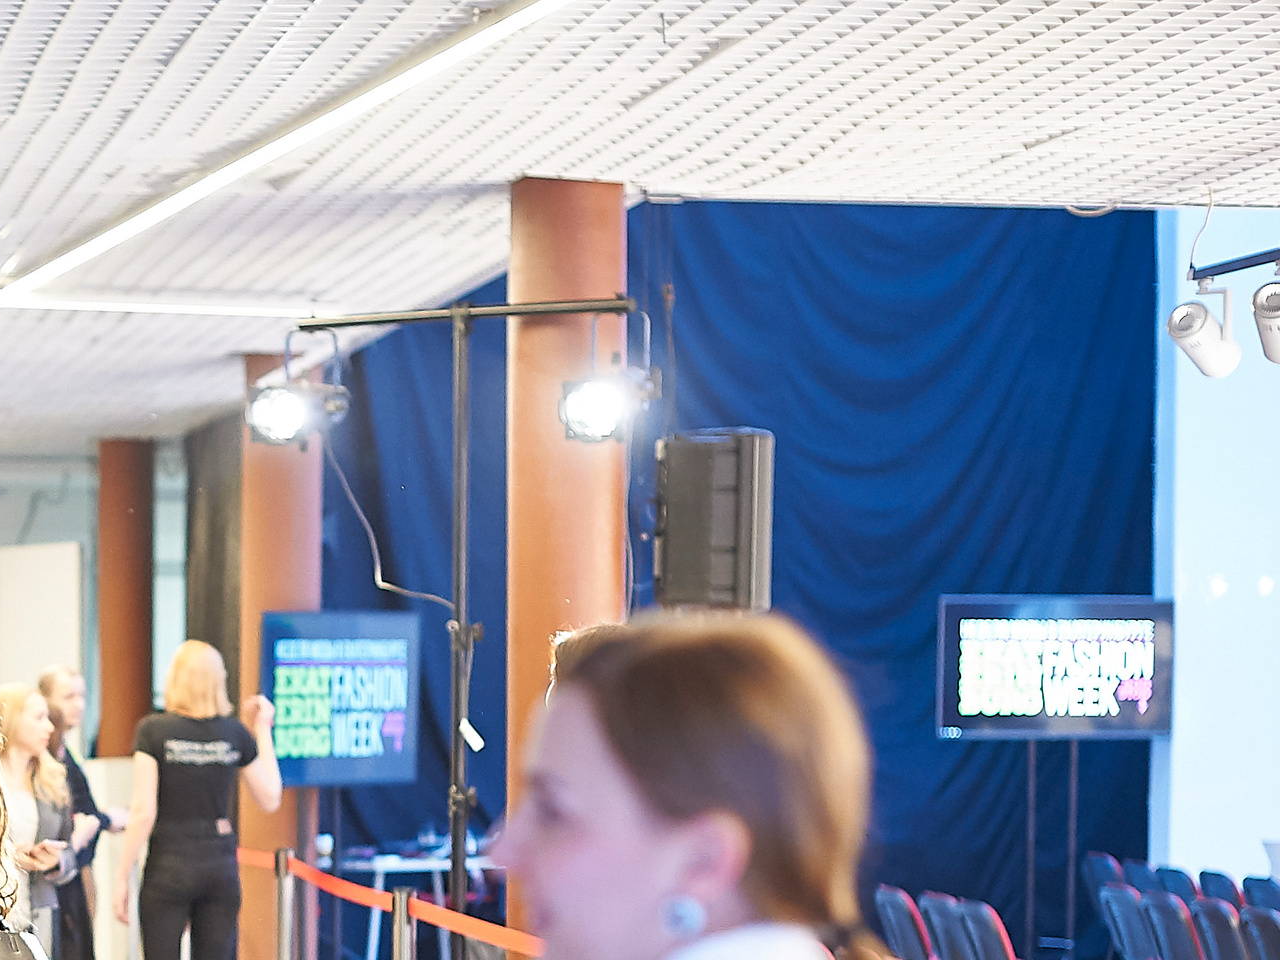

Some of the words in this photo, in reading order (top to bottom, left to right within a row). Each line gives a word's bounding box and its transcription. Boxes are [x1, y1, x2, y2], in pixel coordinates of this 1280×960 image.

[1043, 641, 1154, 680] FASHION
[332, 667, 407, 710] FASHION
[1043, 679, 1120, 717] WEEK
[333, 712, 384, 757] WEEK
